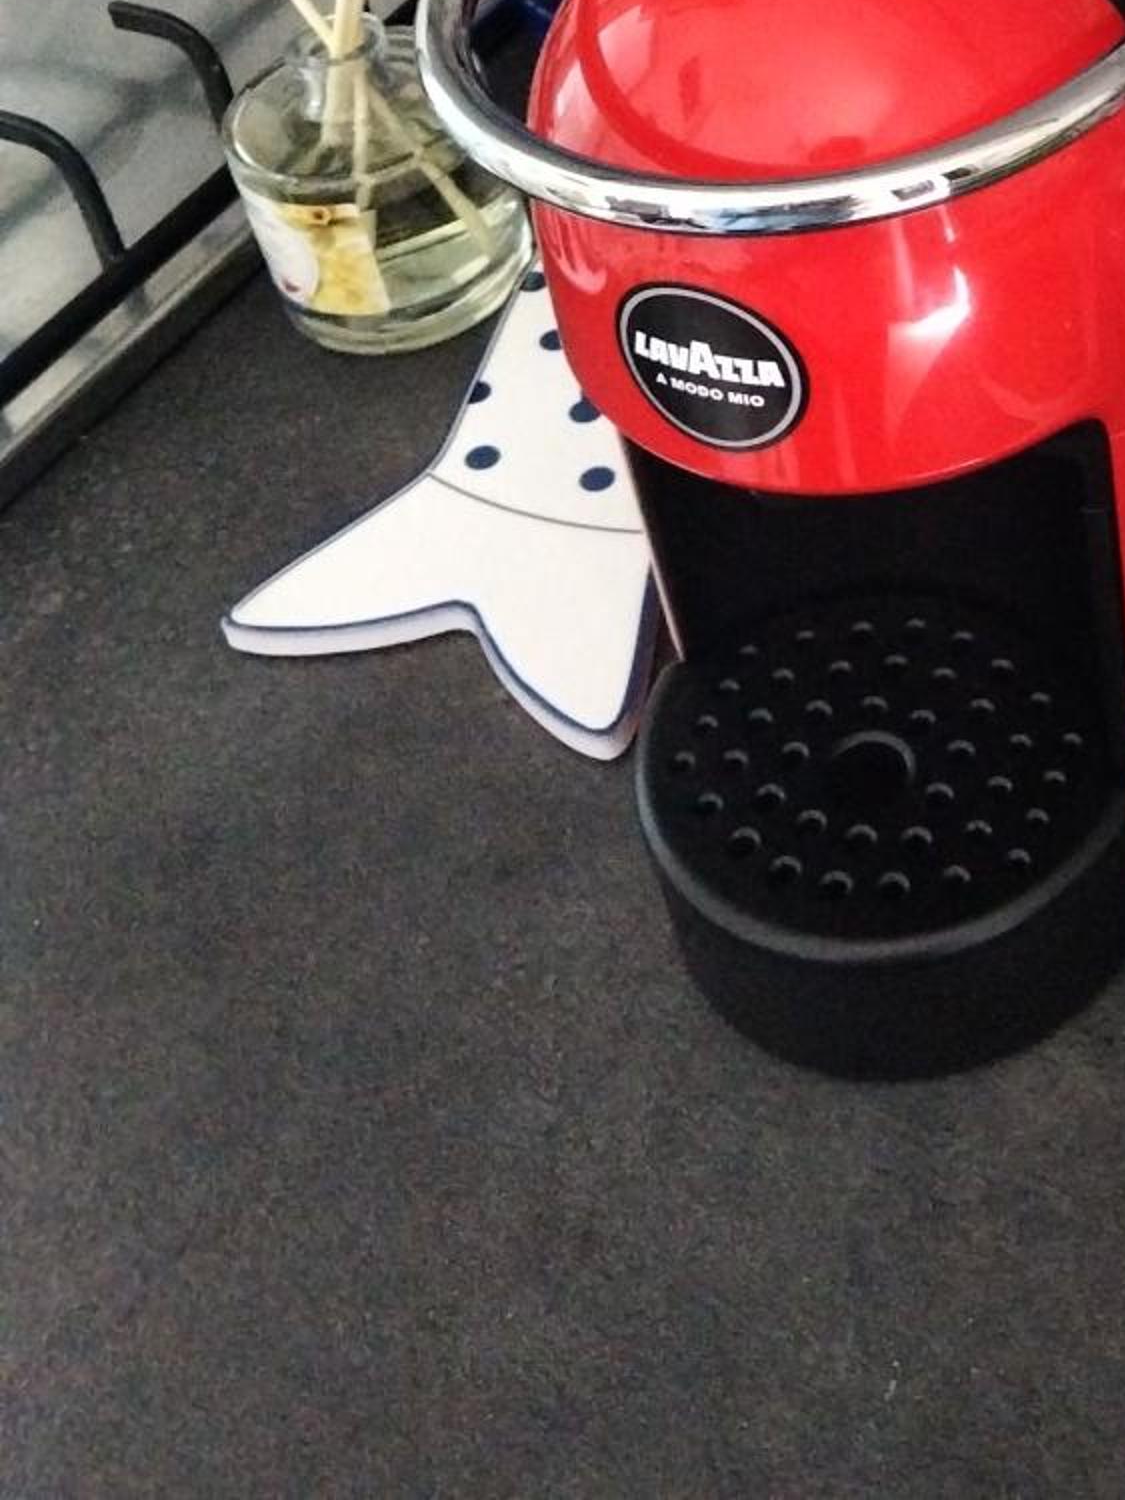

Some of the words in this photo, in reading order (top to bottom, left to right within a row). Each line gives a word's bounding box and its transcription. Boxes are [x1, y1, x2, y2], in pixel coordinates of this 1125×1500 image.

[635, 330, 785, 388] LAVAZZA
[656, 372, 668, 385] A
[670, 377, 724, 401] MODO
[727, 391, 765, 407] MIO
